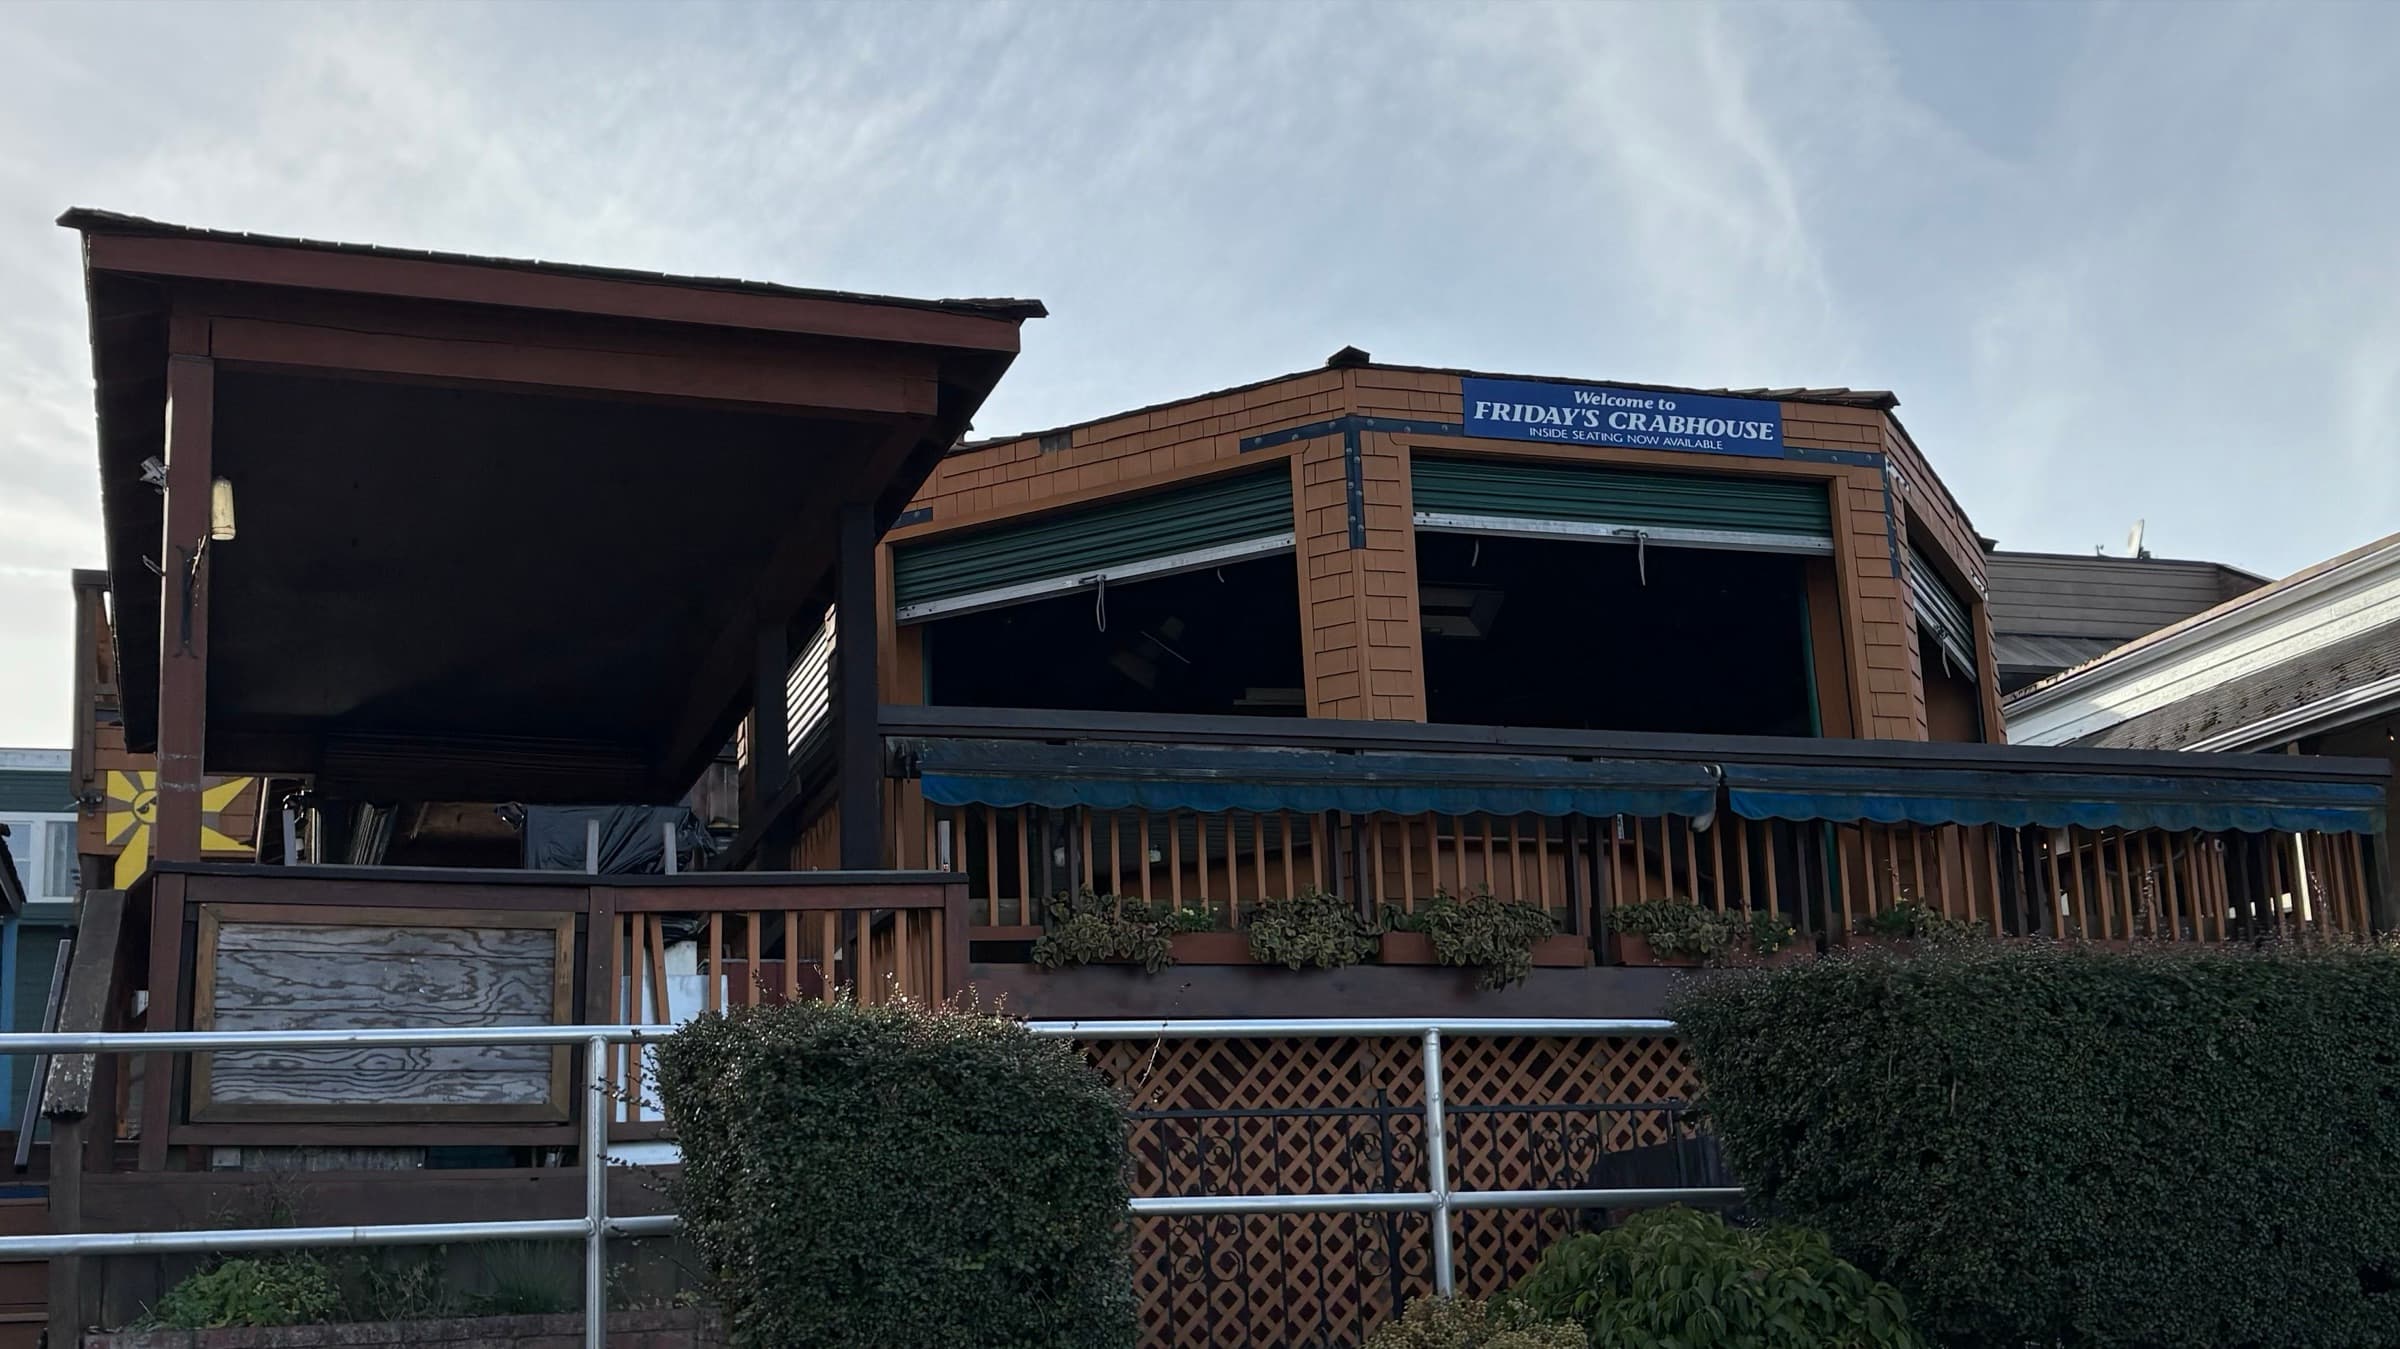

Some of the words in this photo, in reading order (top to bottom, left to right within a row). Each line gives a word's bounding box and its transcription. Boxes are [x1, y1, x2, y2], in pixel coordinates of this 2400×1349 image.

[1573, 390, 1653, 409] Welcome
[1658, 400, 1676, 411] to
[1474, 401, 1600, 428] FRIDAY'S
[1608, 411, 1774, 441] CRABHOUSE
[1529, 427, 1568, 439] INSIDE
[1572, 430, 1623, 443] SEATING
[1627, 434, 1659, 445] NOW
[1662, 437, 1723, 450] AVAILABLE
